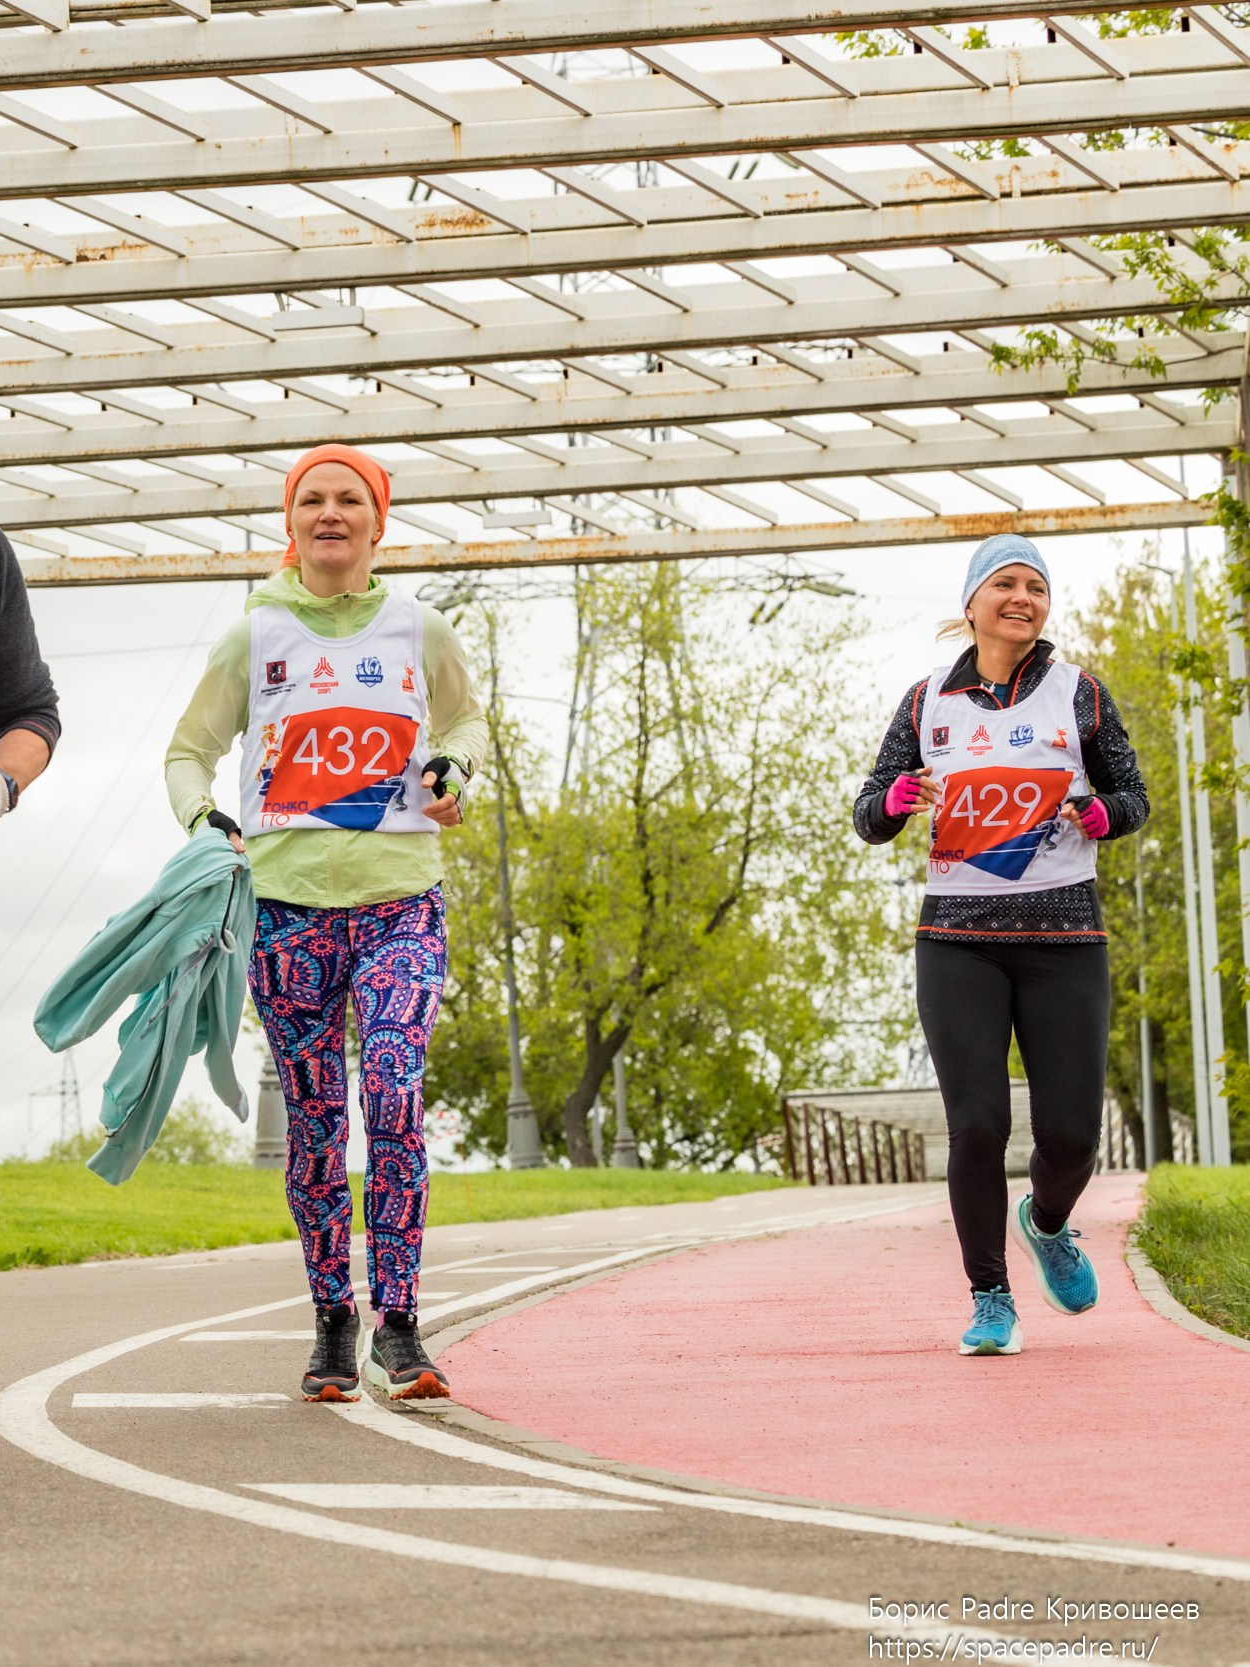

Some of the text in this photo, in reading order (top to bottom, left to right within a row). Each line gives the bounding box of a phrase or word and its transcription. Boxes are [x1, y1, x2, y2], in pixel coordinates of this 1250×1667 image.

[292, 726, 392, 776] 432
[261, 813, 290, 828] ГТО
[950, 782, 1042, 828] 429
